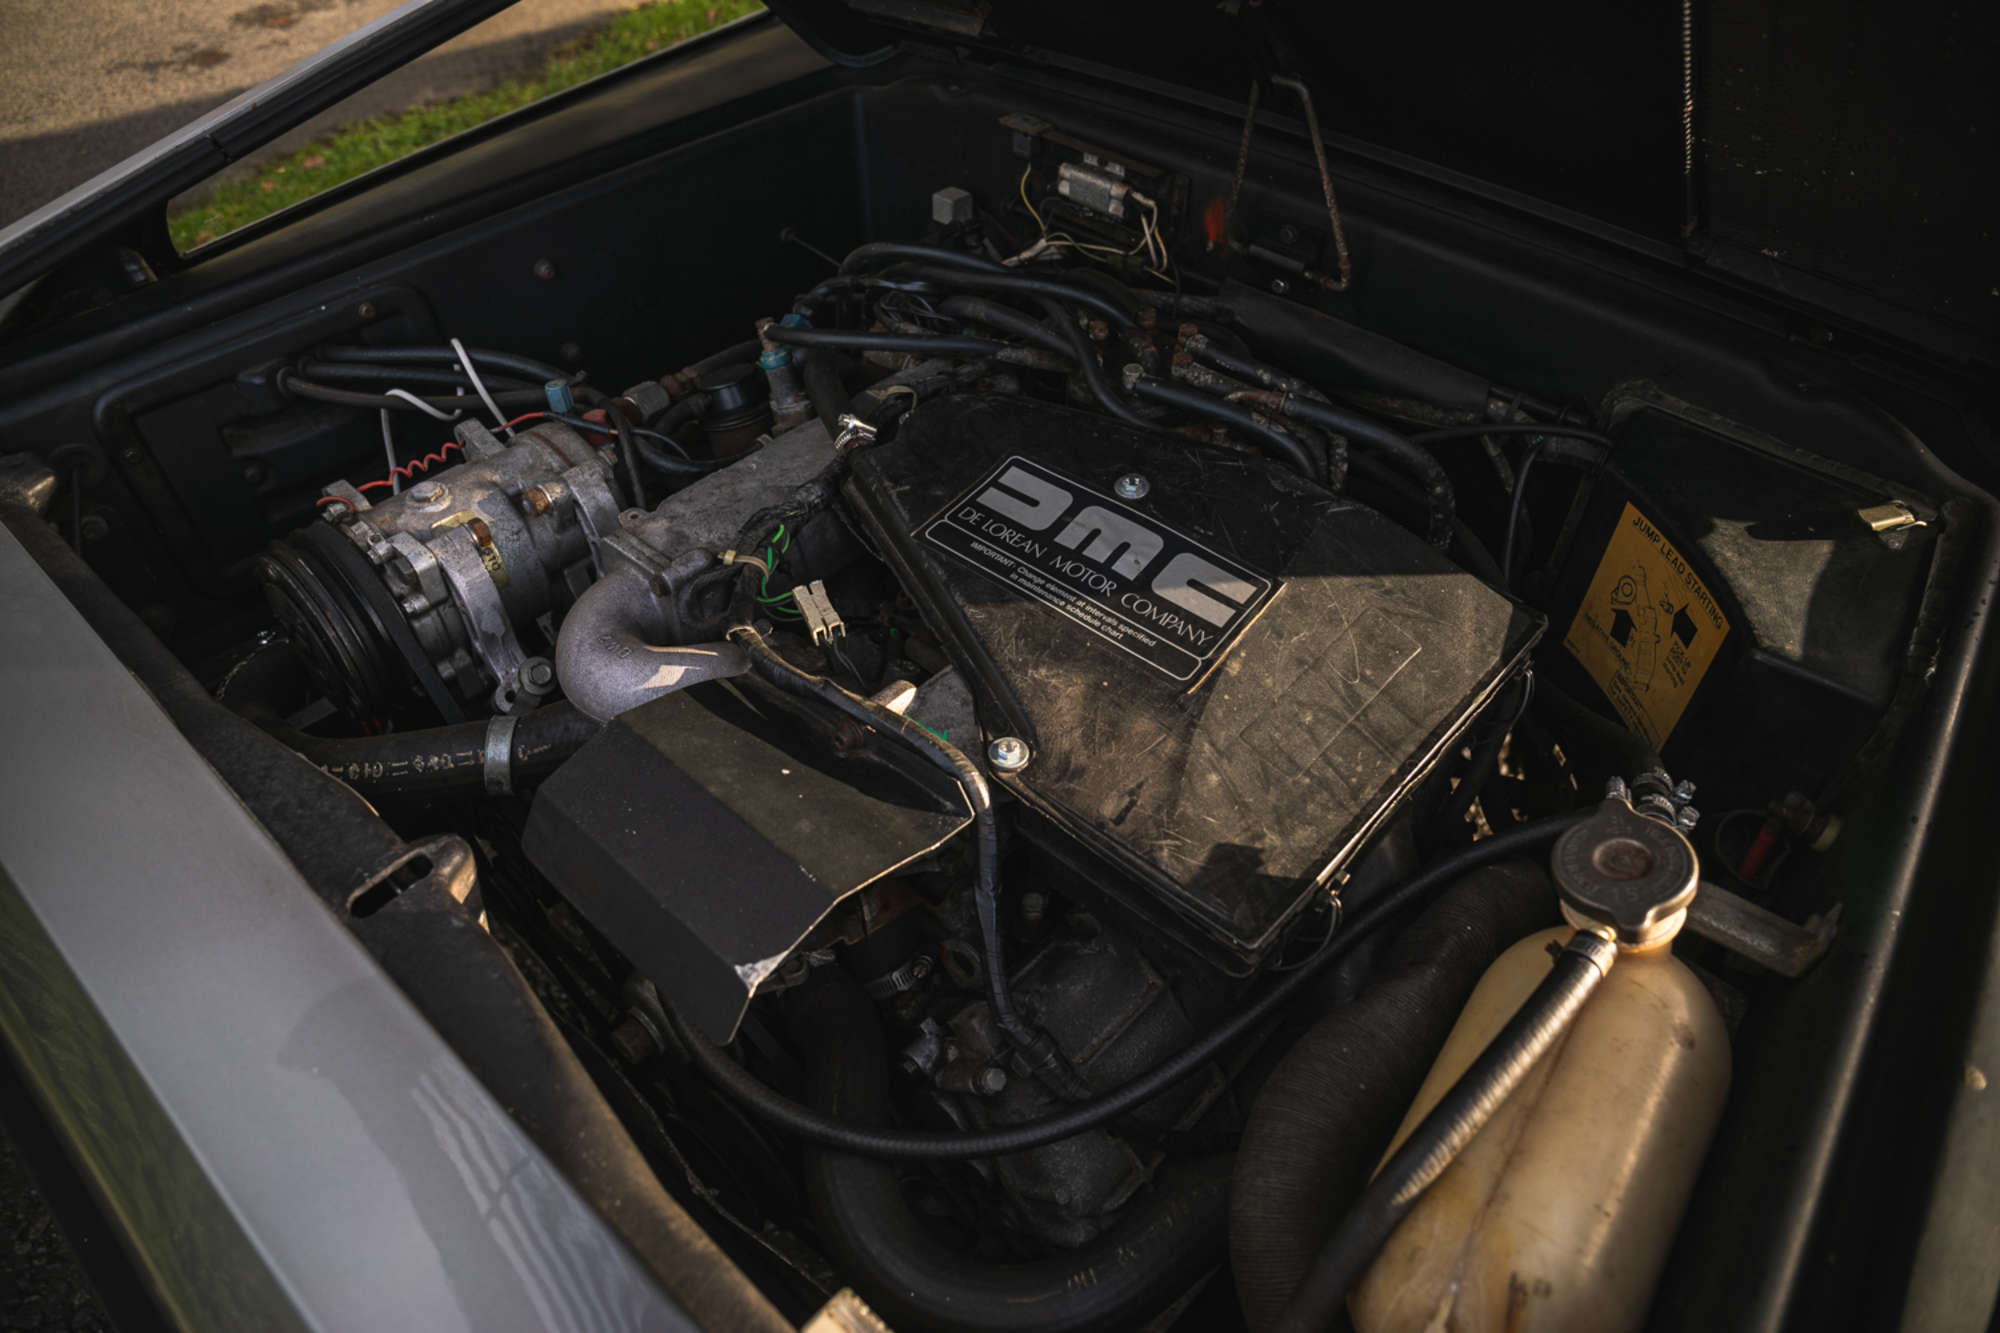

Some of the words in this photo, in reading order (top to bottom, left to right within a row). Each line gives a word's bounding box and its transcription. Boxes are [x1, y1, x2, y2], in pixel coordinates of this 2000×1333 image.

[957, 506, 983, 525] DE
[981, 519, 1047, 559] LOREAN
[1049, 554, 1118, 597] MOTOR
[1120, 592, 1215, 647] COMPANY
[1017, 565, 1045, 586] Change
[1118, 623, 1157, 647] specified
[1632, 517, 1660, 543] JUMP
[1660, 543, 1686, 575] LEAD
[1685, 572, 1724, 629] STARTING
[1100, 622, 1124, 640] chart
